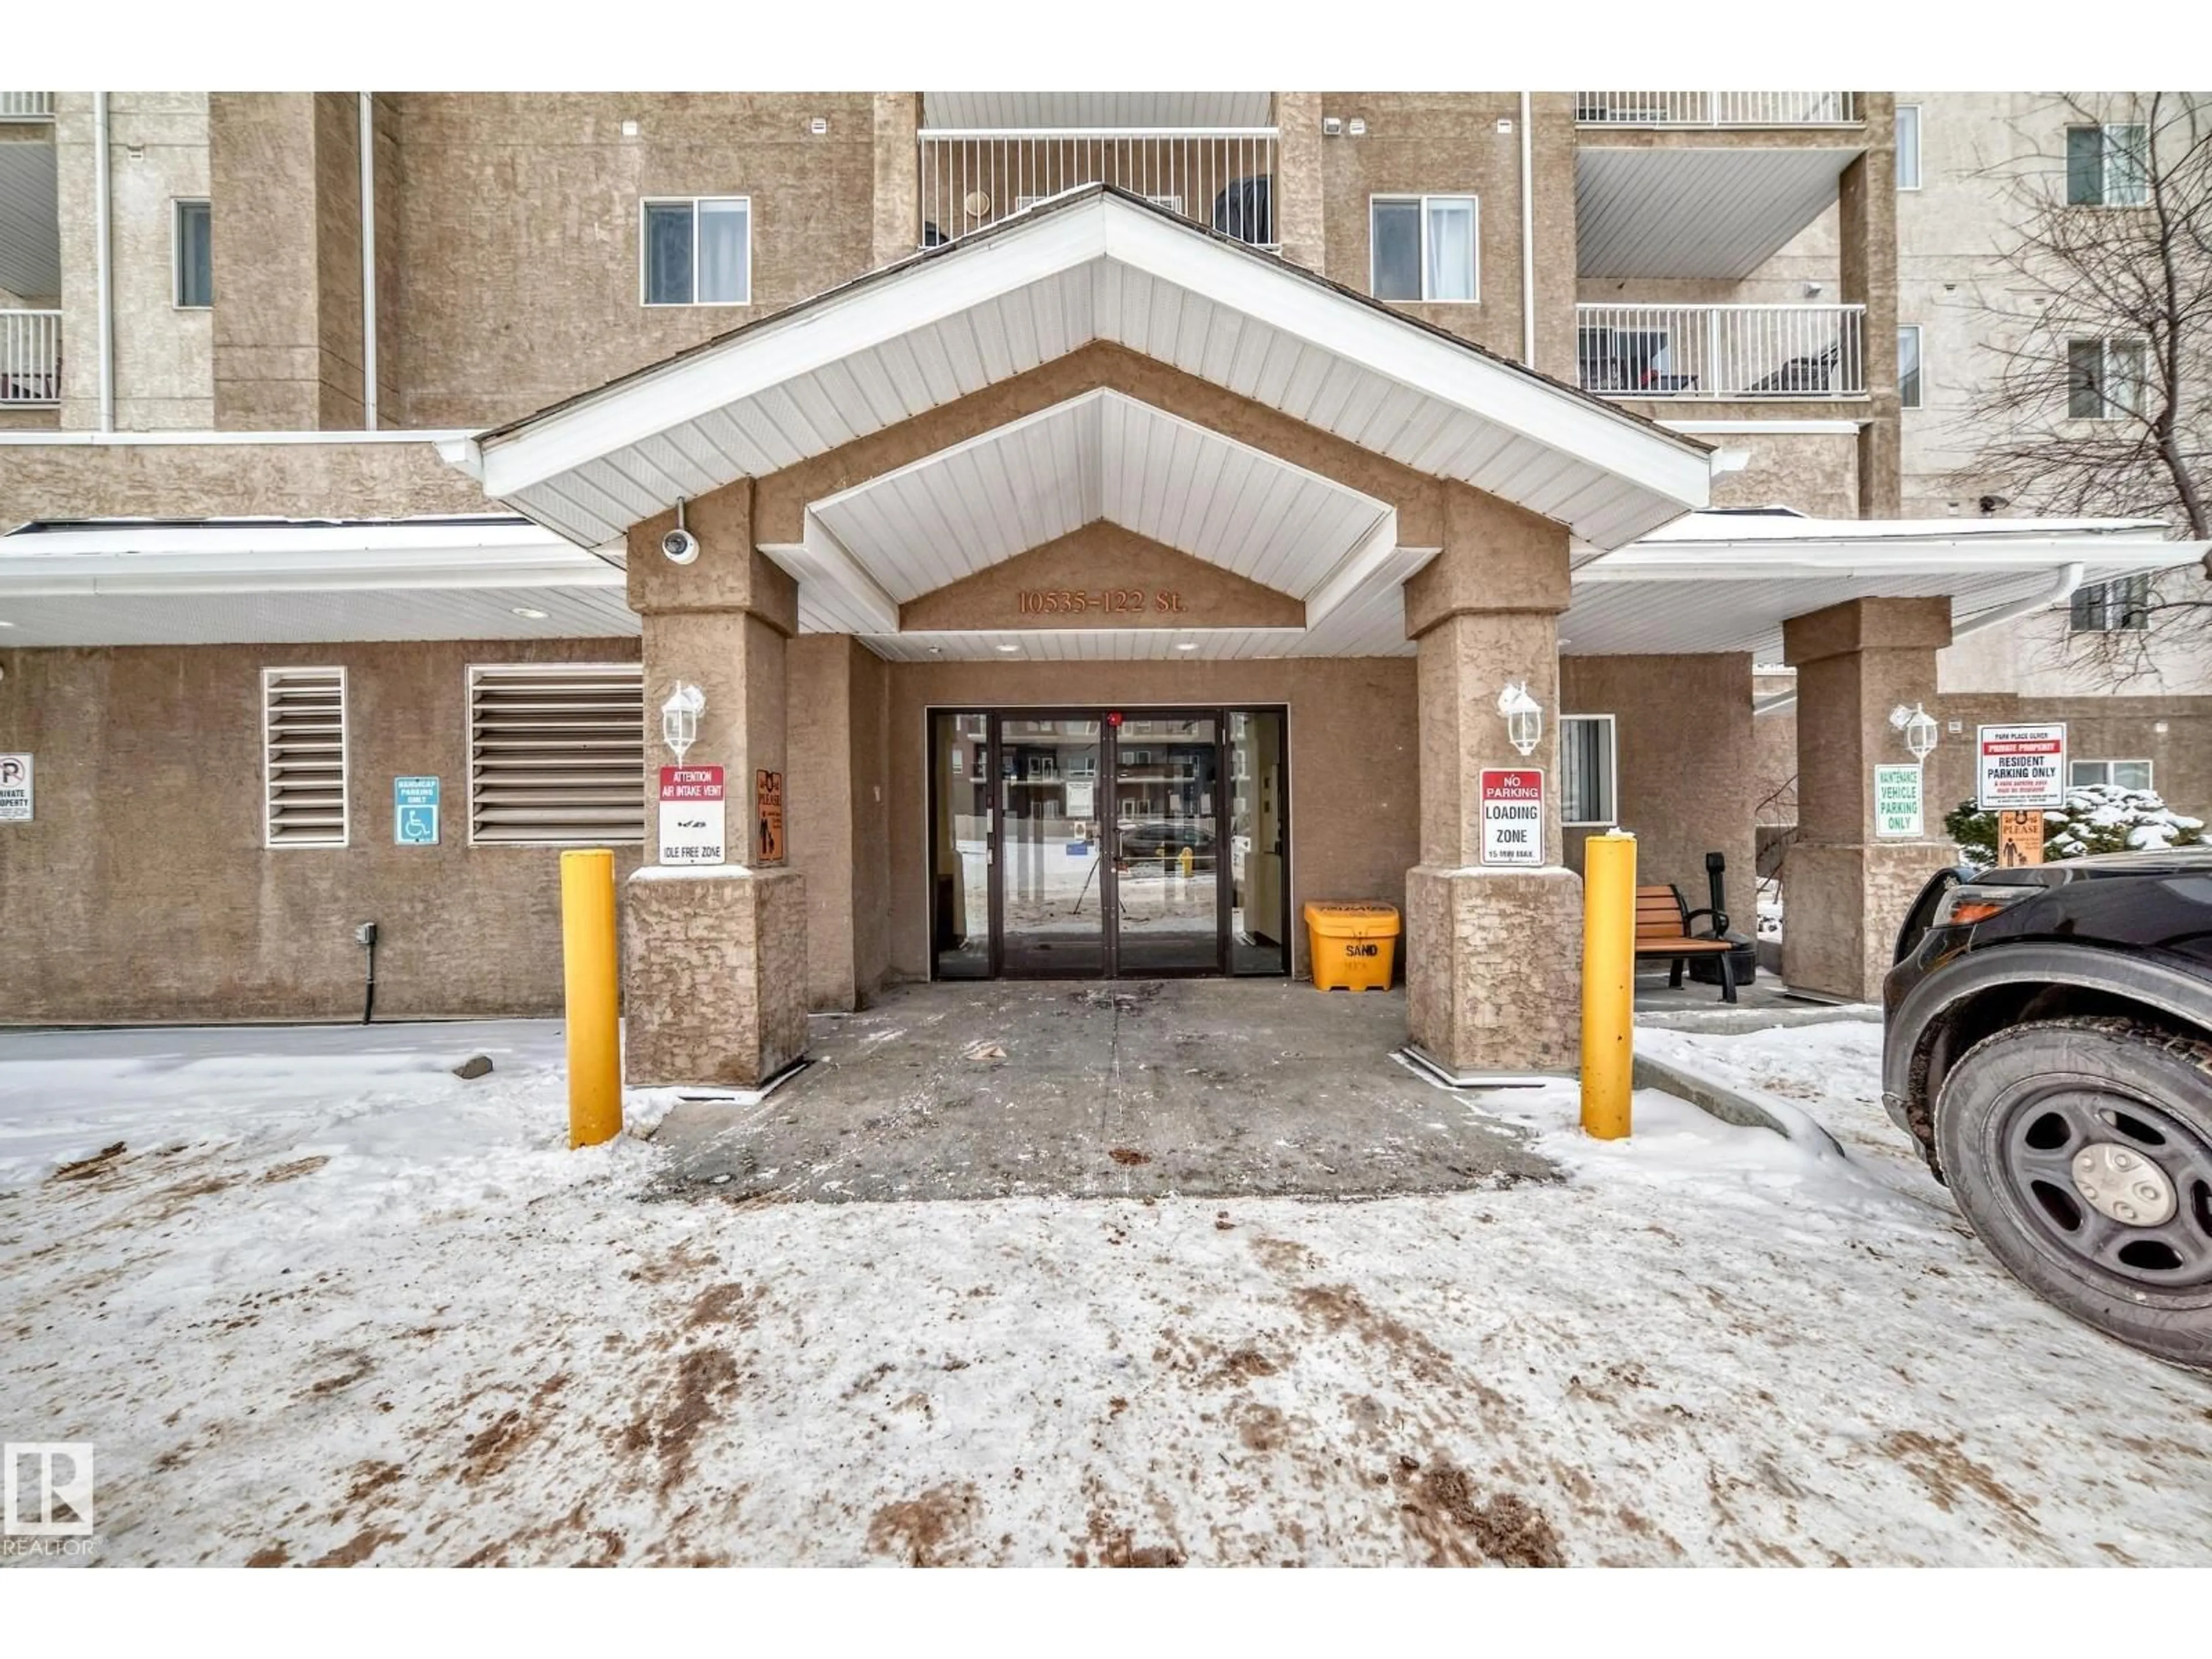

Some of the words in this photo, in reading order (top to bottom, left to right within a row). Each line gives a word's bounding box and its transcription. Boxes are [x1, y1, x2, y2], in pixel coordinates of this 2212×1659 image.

[1018, 591, 1145, 613] 10535-122
[1156, 592, 1188, 613] St.
[1999, 756, 2044, 767] RESIDENT
[673, 771, 712, 782] ATTENTION
[1987, 768, 2029, 779] PARKING
[2032, 767, 2056, 778] ONLY
[1503, 777, 1521, 787] NO
[662, 785, 674, 797] AIR
[676, 785, 702, 797] INTAKE
[703, 785, 722, 796] VENT
[1486, 788, 1538, 797] PARKING
[1881, 786, 1916, 798] VEHICLE
[1486, 806, 1537, 819] LOADING
[1880, 801, 1917, 815] PARKING
[1888, 817, 1911, 830] ONLY
[1497, 830, 1527, 843] ZONE
[664, 847, 679, 858] IDLE
[681, 846, 699, 857] FREE
[702, 846, 720, 857] ZONE
[1346, 944, 1378, 957] SAND
